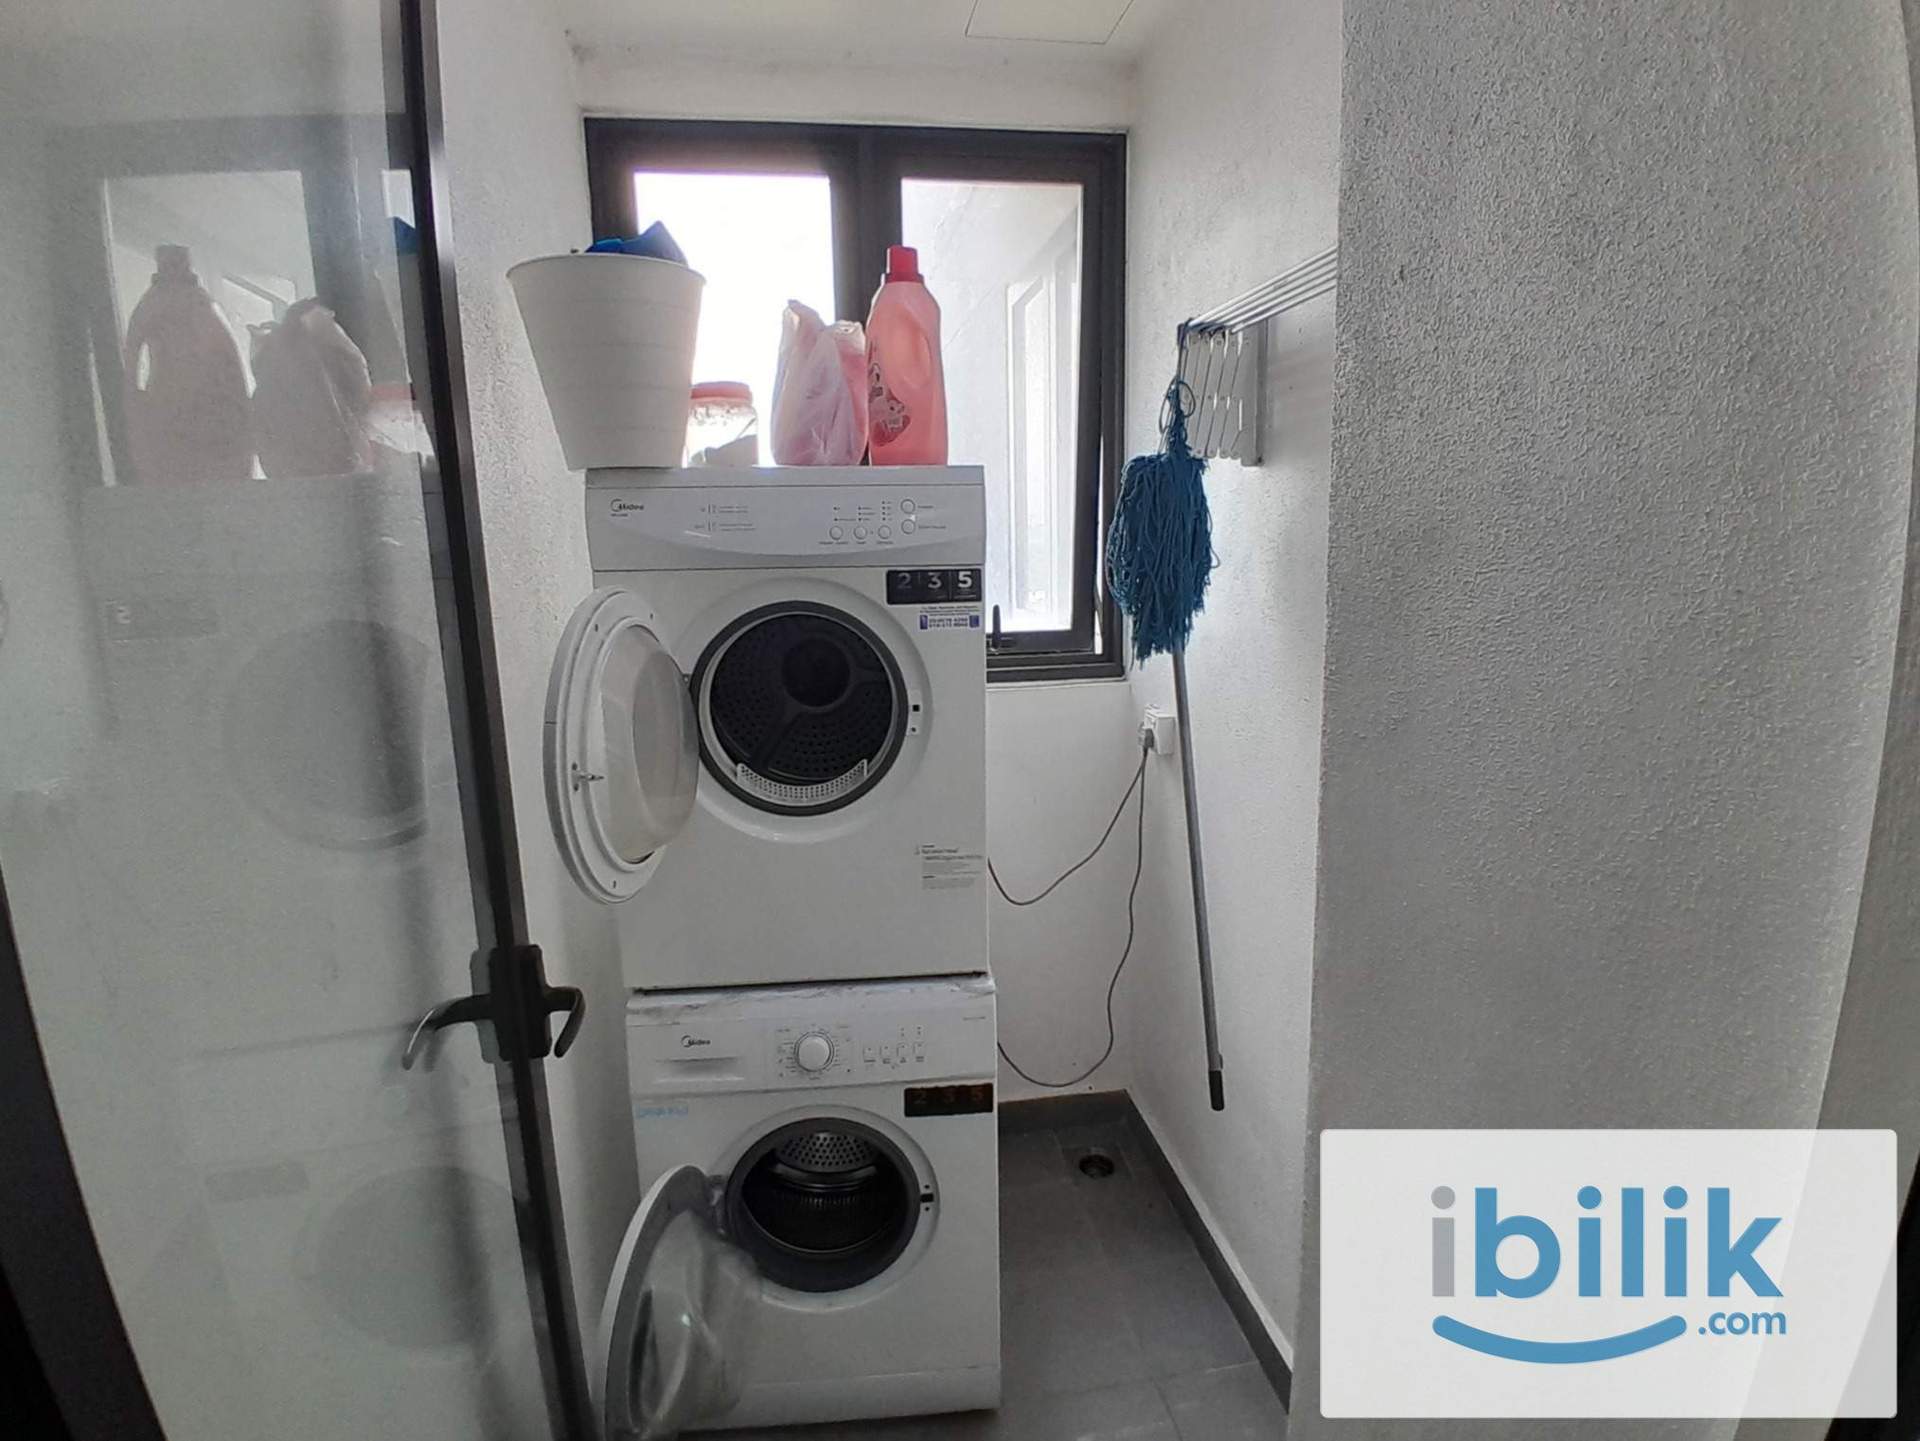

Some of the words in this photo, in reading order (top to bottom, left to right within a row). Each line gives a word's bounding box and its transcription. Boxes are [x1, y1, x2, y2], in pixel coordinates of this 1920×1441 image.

[611, 499, 644, 512] Midea
[927, 571, 942, 589] 3
[957, 570, 973, 588] 5
[681, 1035, 711, 1048] Midea
